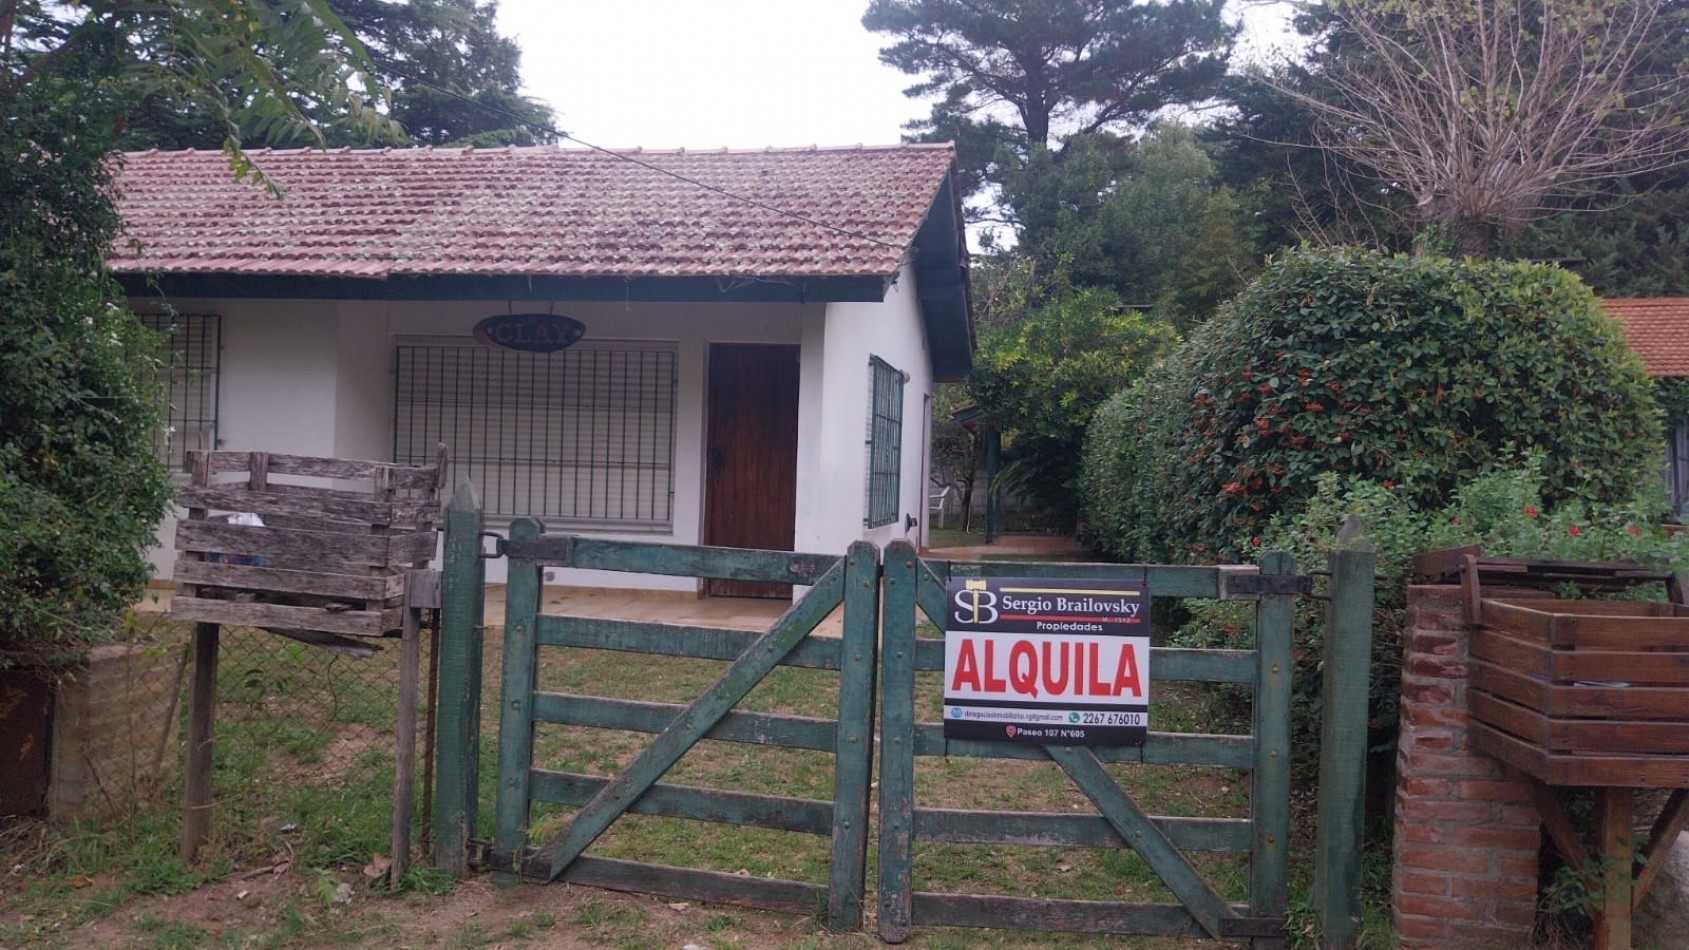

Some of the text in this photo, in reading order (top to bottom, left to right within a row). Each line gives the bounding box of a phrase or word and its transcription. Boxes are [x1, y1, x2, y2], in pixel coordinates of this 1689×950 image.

[495, 323, 571, 344] CLAY
[1002, 596, 1140, 617] Sergio Brailovsky
[1036, 621, 1103, 632] Propiedades
[951, 638, 1142, 699] ALQUILA
[1083, 713, 1140, 726] 2267 676010
[1017, 728, 1042, 737] Paseo
[1044, 729, 1059, 737] 107
